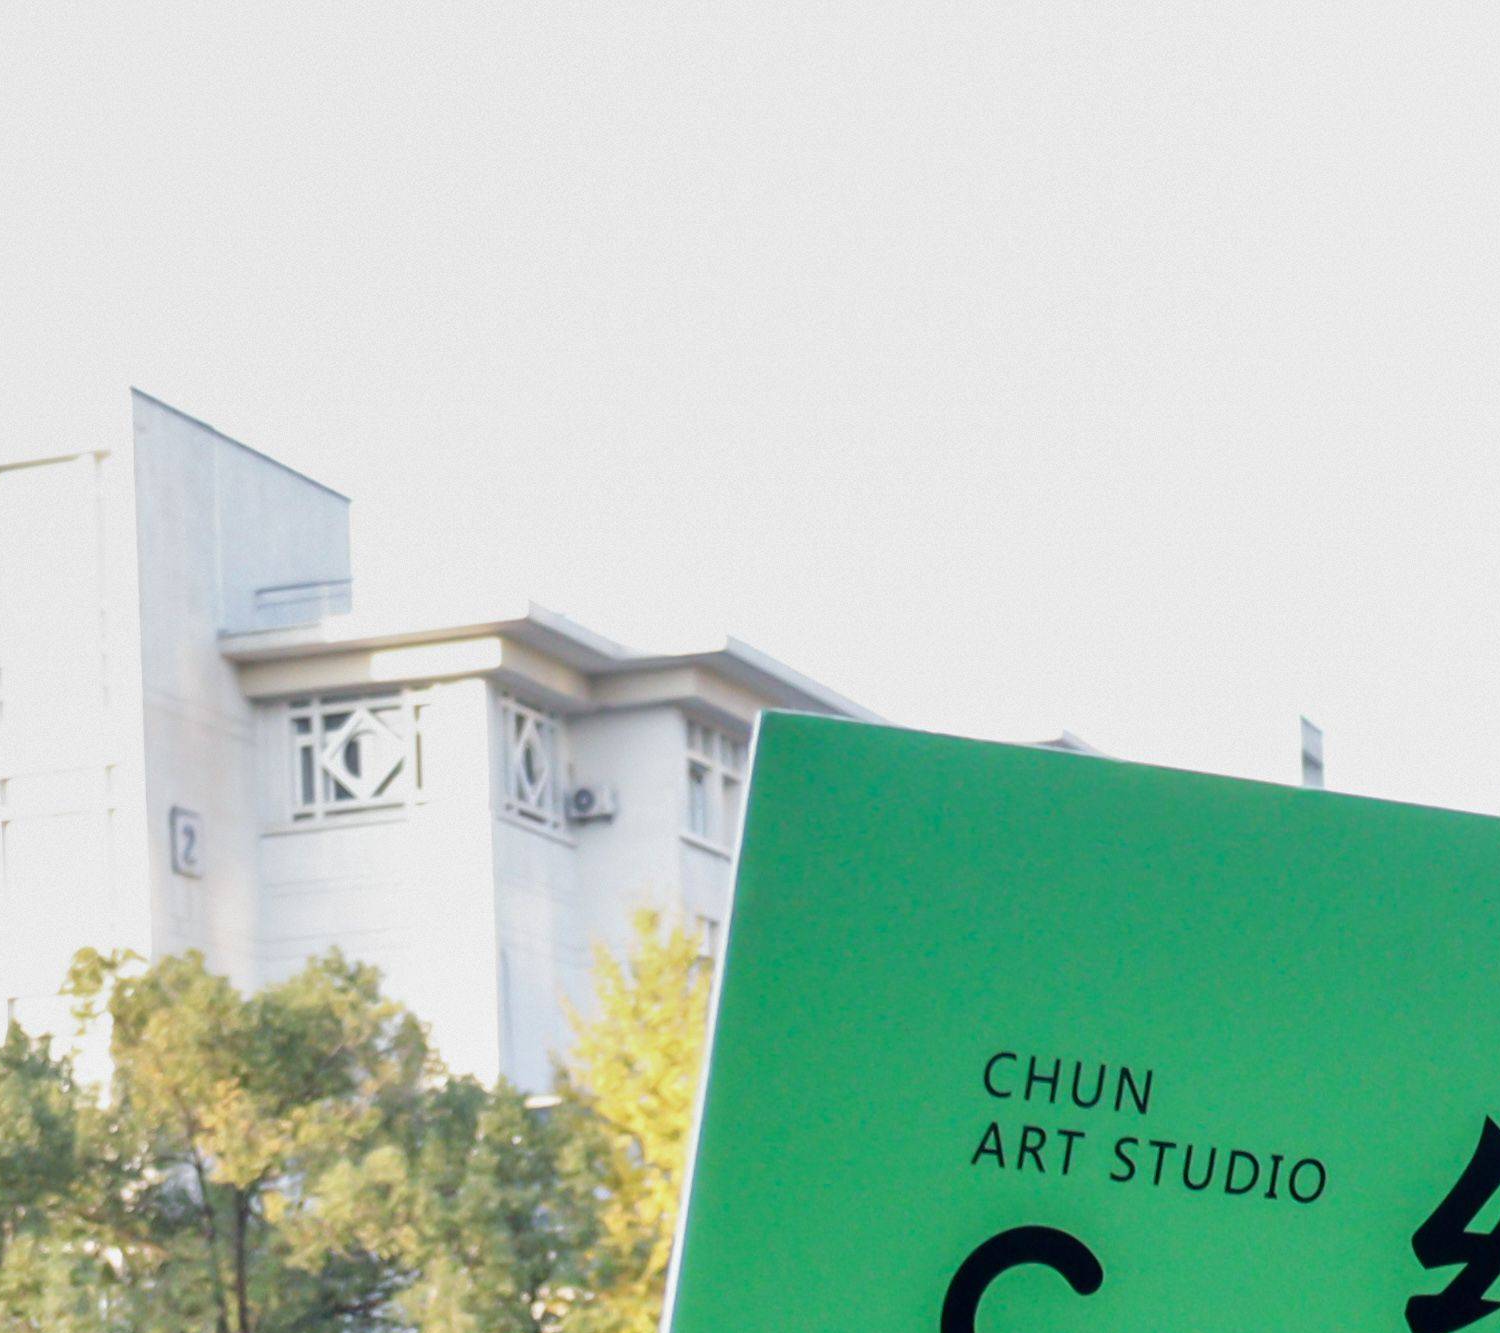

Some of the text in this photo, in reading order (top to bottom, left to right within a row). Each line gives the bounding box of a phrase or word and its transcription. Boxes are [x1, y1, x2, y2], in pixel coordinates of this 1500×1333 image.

[982, 1051, 1156, 1116] CHUN
[971, 1121, 1328, 1204] ART STUDIO
